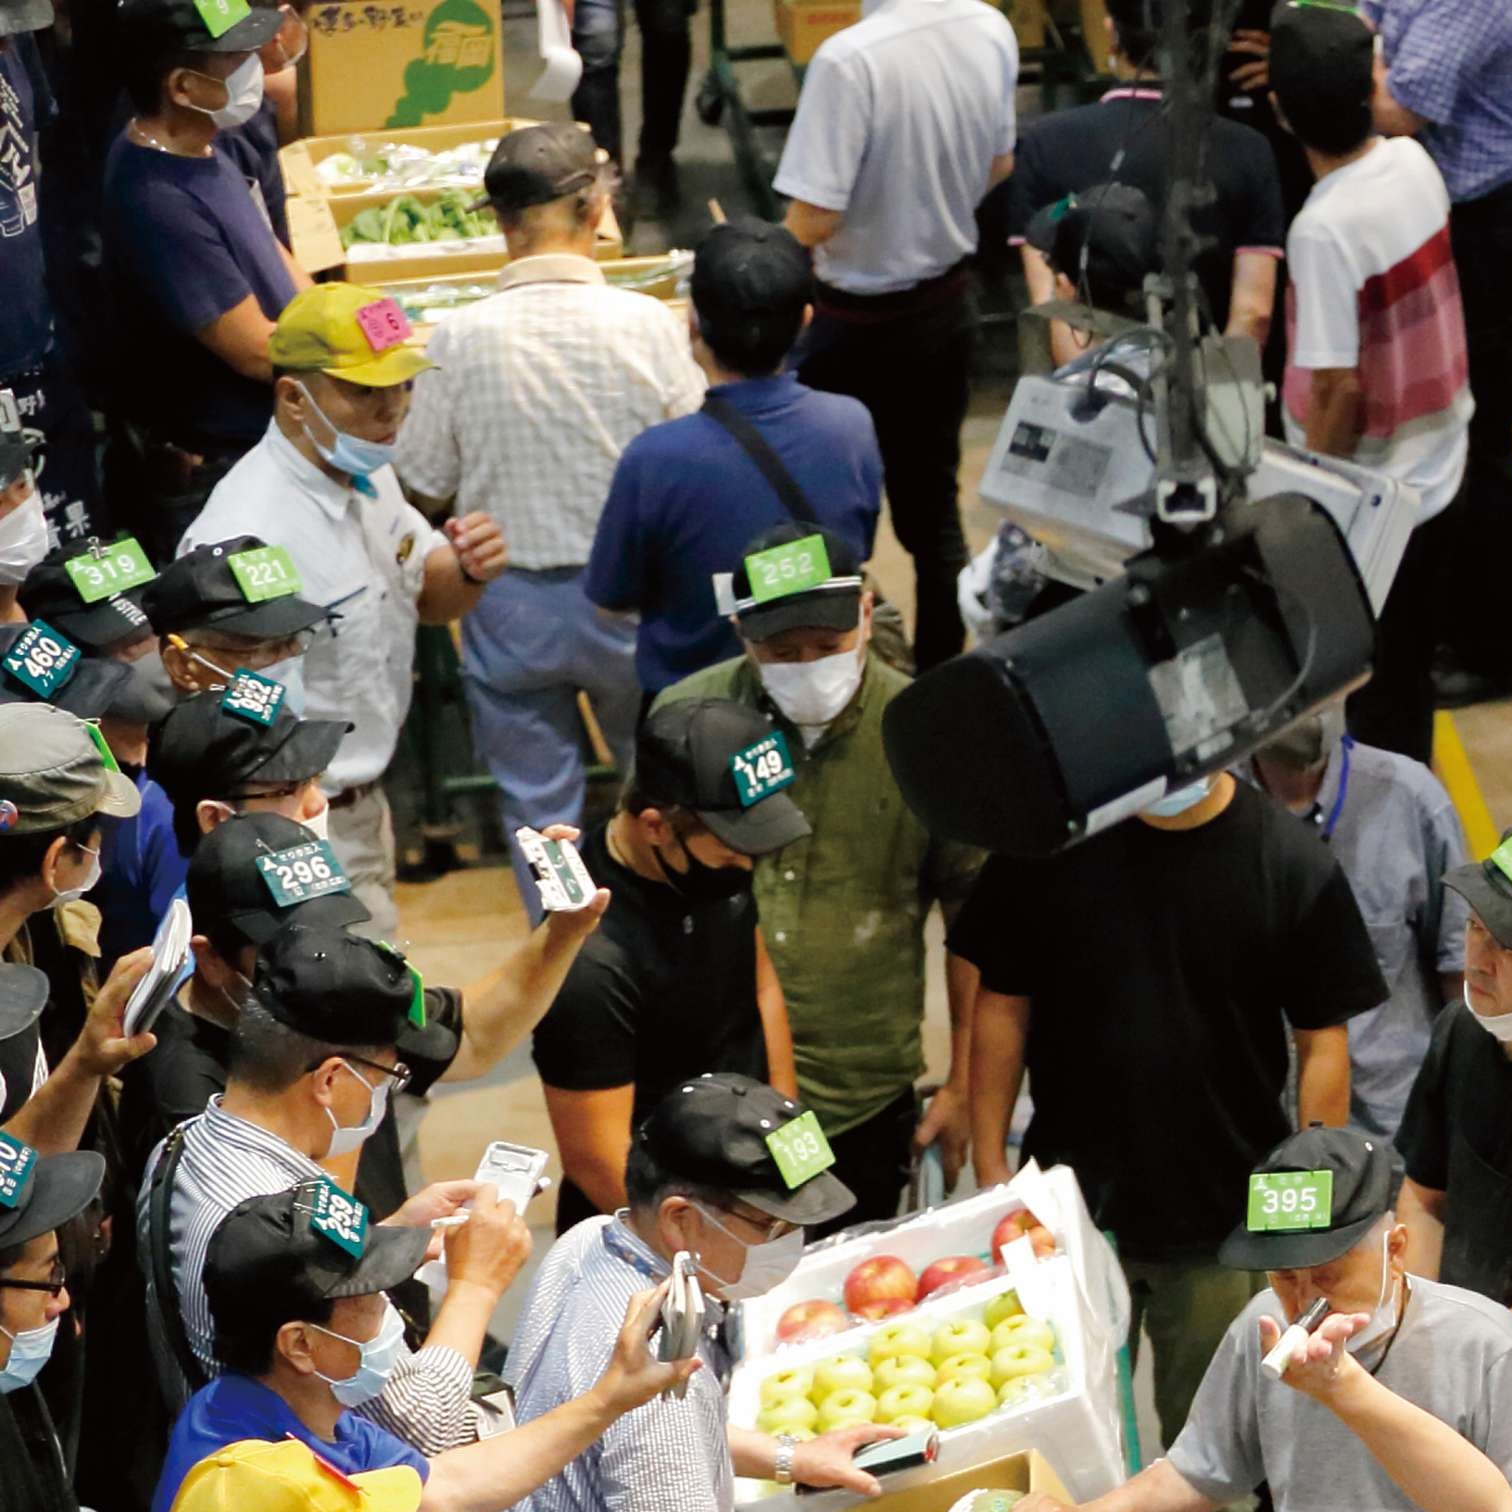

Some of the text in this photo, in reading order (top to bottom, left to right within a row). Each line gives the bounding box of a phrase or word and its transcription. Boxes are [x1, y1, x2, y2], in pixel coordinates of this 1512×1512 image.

[85, 554, 136, 585] 319
[246, 559, 287, 587] 221
[764, 552, 814, 585] 252
[24, 637, 61, 678] 460
[743, 750, 783, 785] 149
[276, 855, 331, 890] 296
[783, 1131, 819, 1167] 193
[327, 1194, 354, 1241] 259
[1262, 1187, 1318, 1214] 395
